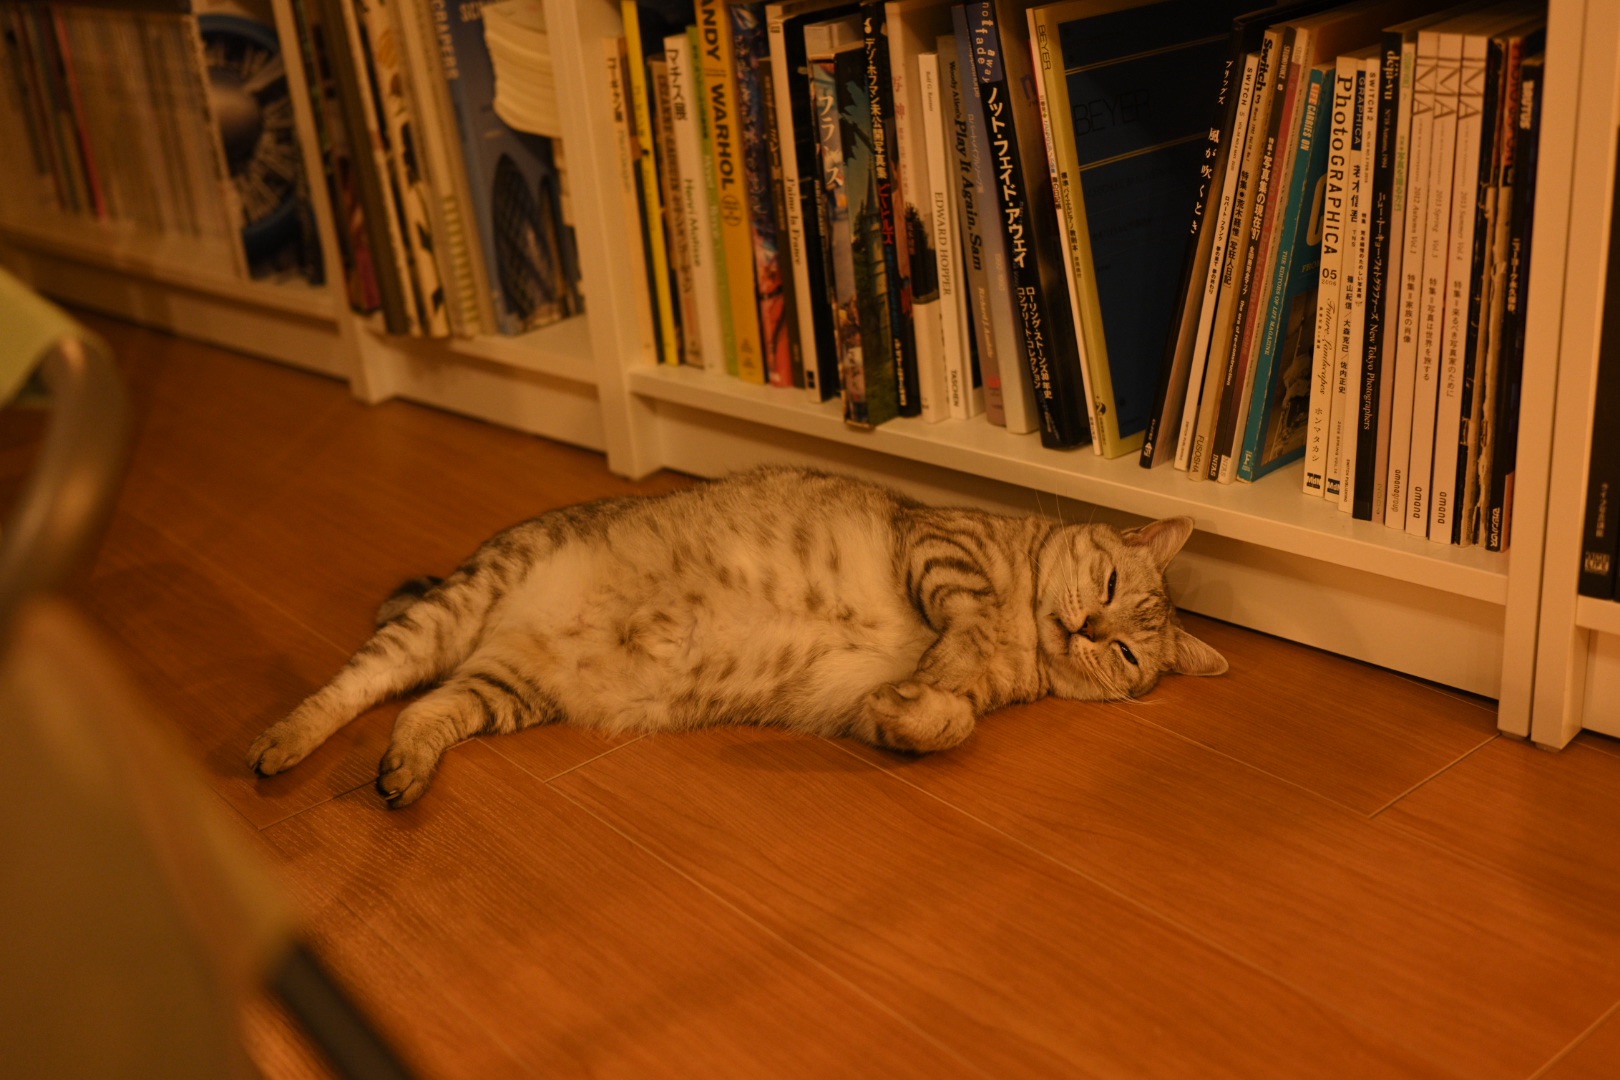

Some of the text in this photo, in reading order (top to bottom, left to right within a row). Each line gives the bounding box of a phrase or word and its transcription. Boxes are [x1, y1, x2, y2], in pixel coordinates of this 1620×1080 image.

[982, 0, 994, 26] not
[975, 28, 989, 65] fade
[982, 49, 995, 83] away
[1037, 24, 1051, 71] BEYER
[1256, 38, 1273, 92] Switch
[949, 60, 959, 89] Woody
[1241, 67, 1254, 106] SWITCH
[1368, 72, 1376, 113] SWITCH
[1382, 50, 1401, 100] déjà-vu
[1412, 55, 1437, 116] IMA
[1433, 56, 1460, 119] IMA
[1458, 57, 1486, 120] IMA
[1073, 88, 1152, 137] BEYER
[1300, 82, 1320, 151] LIFE CARRIES ON
[1354, 76, 1366, 145] GRAPHICA
[1519, 79, 1535, 130] BRUTUS
[710, 83, 735, 191] WARHOL
[684, 178, 694, 218] Henri
[954, 119, 983, 271] Play It Again, Sam
[988, 86, 1026, 269] ノット・フェイド・アウェイ
[1190, 127, 1221, 235] 風が吹くとき
[1410, 205, 1420, 233] Autumn
[1431, 207, 1442, 232] Spring
[1457, 209, 1467, 238] Summer
[791, 227, 801, 265] France
[934, 191, 952, 296] EDWARD HOPPER
[1275, 264, 1287, 294] EDITORS
[1322, 268, 1337, 280] 05
[1264, 319, 1276, 355] MAGAZINE
[1326, 298, 1336, 336] Future
[1226, 335, 1239, 386] re-construction
[1317, 335, 1332, 395] Landscapes
[1363, 324, 1378, 430] New Tokyo Photographers
[950, 370, 960, 407] TASCHEN
[1191, 435, 1205, 473] FUSOSHA
[1311, 407, 1323, 462] ホンマタカシ
[1412, 486, 1423, 519] amana
[1437, 491, 1447, 524] amana
[1490, 506, 1501, 548] マガジンハウス
